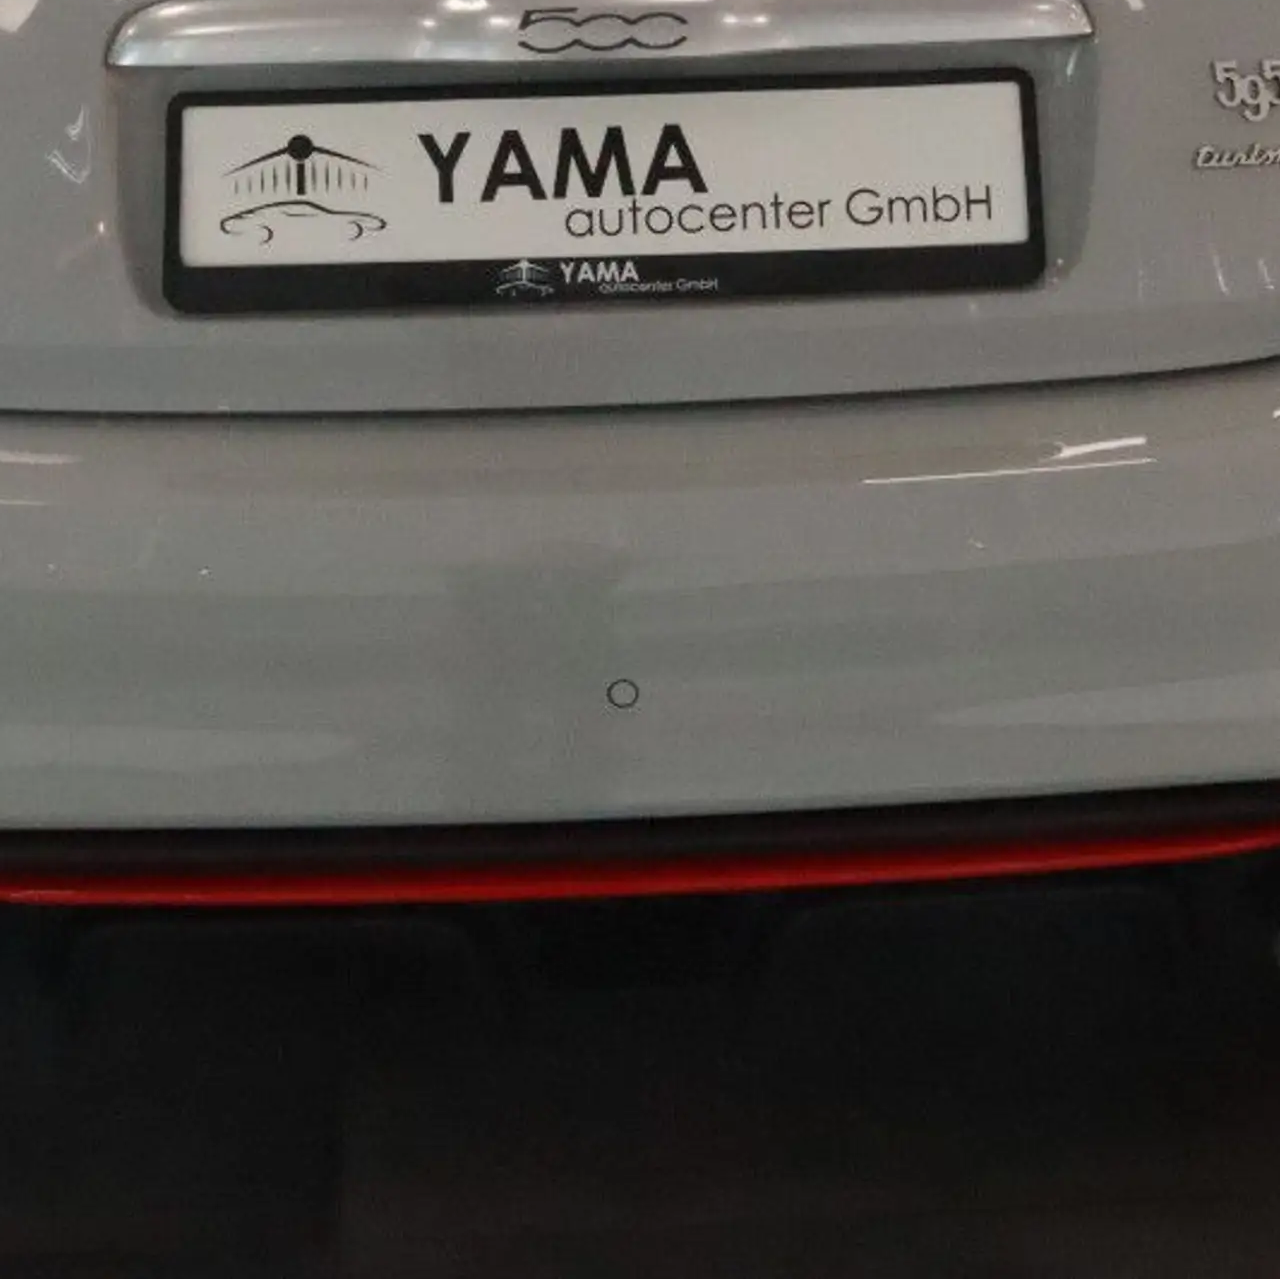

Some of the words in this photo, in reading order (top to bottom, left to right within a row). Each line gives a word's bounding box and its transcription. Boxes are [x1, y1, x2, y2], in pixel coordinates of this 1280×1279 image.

[517, 6, 689, 54] 500
[418, 122, 708, 206] YAMA
[565, 194, 833, 239] autocenter
[843, 183, 993, 228] GmbH
[559, 260, 640, 284] YAMA
[675, 277, 719, 292] GmbH
